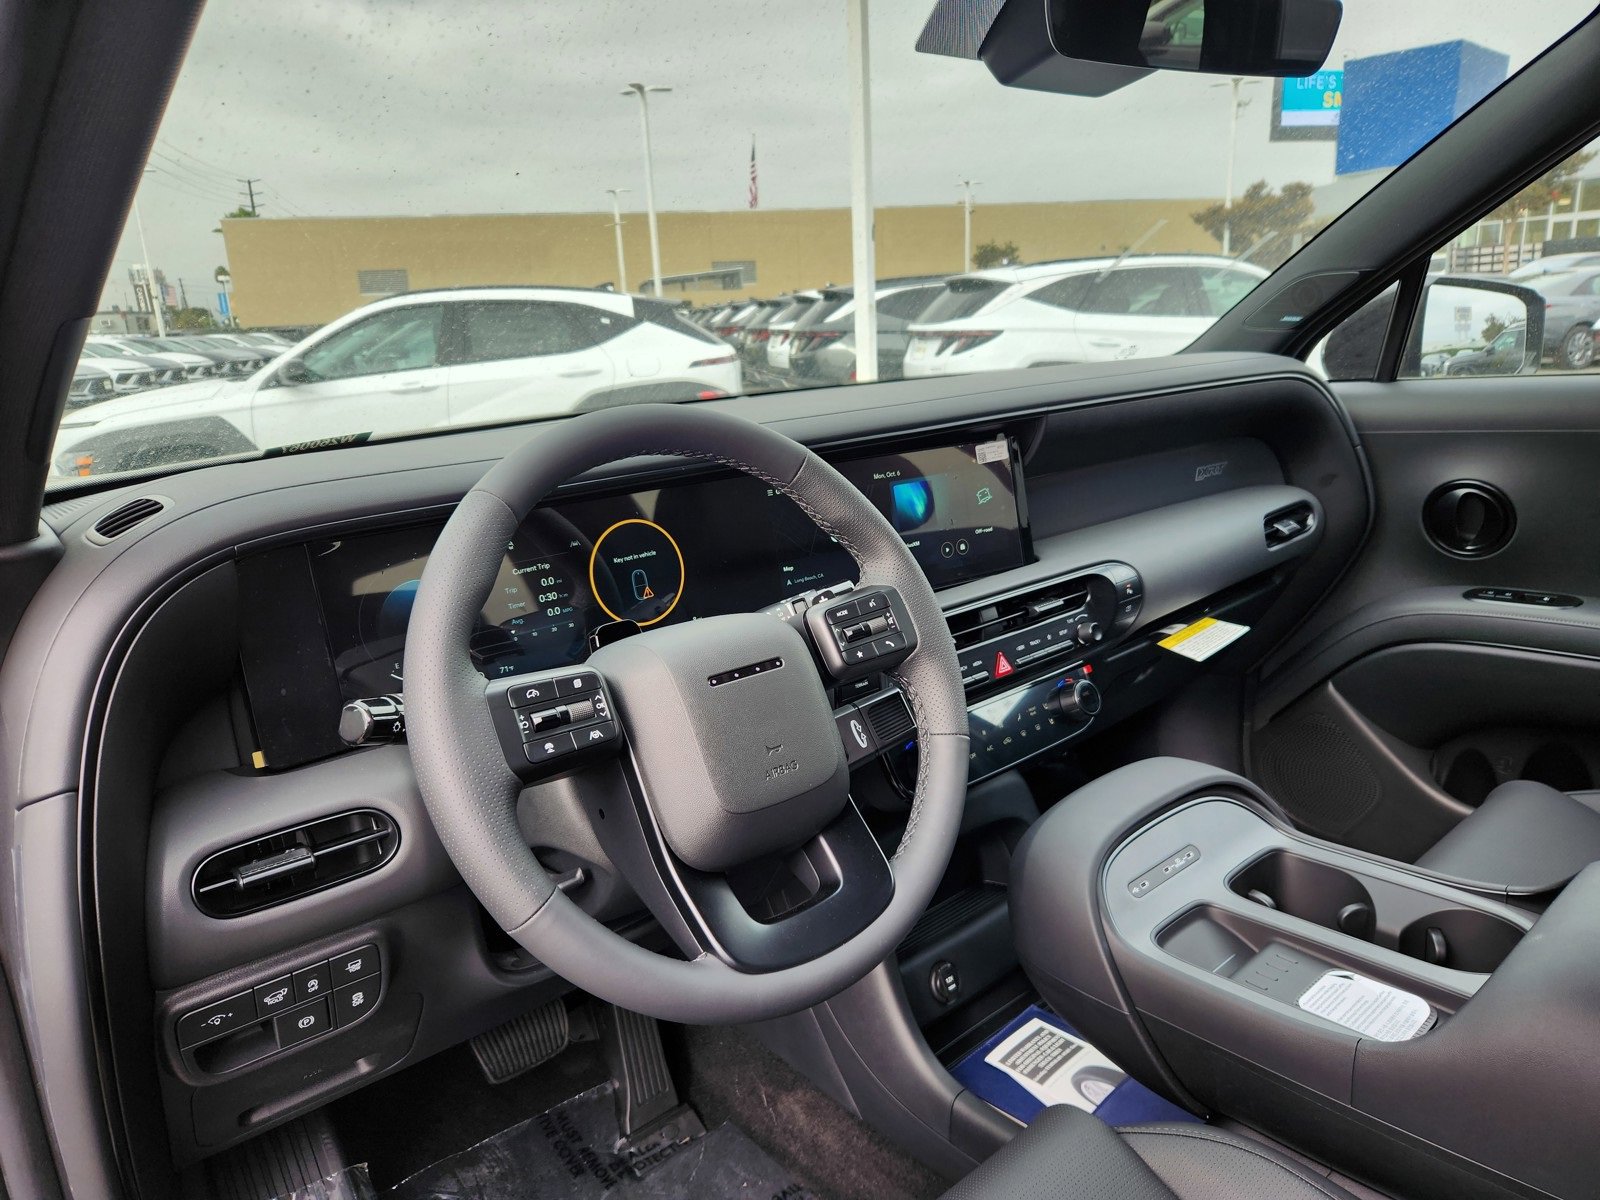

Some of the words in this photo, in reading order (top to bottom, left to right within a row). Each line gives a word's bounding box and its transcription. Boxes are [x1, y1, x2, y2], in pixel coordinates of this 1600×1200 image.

[1296, 74, 1336, 89] LIFE'S
[639, 550, 656, 558] vehicle
[512, 565, 537, 575] Current
[504, 587, 517, 595] Trip
[541, 577, 554, 587] 0.0
[508, 602, 526, 610] Timer
[538, 591, 558, 603] 0:30
[547, 606, 561, 616] 0.0
[836, 609, 848, 617] MODE
[766, 760, 799, 780] AIRBAG
[307, 985, 319, 993] OFF
[267, 996, 284, 1006] HOLD
[351, 998, 364, 1007] OFF
